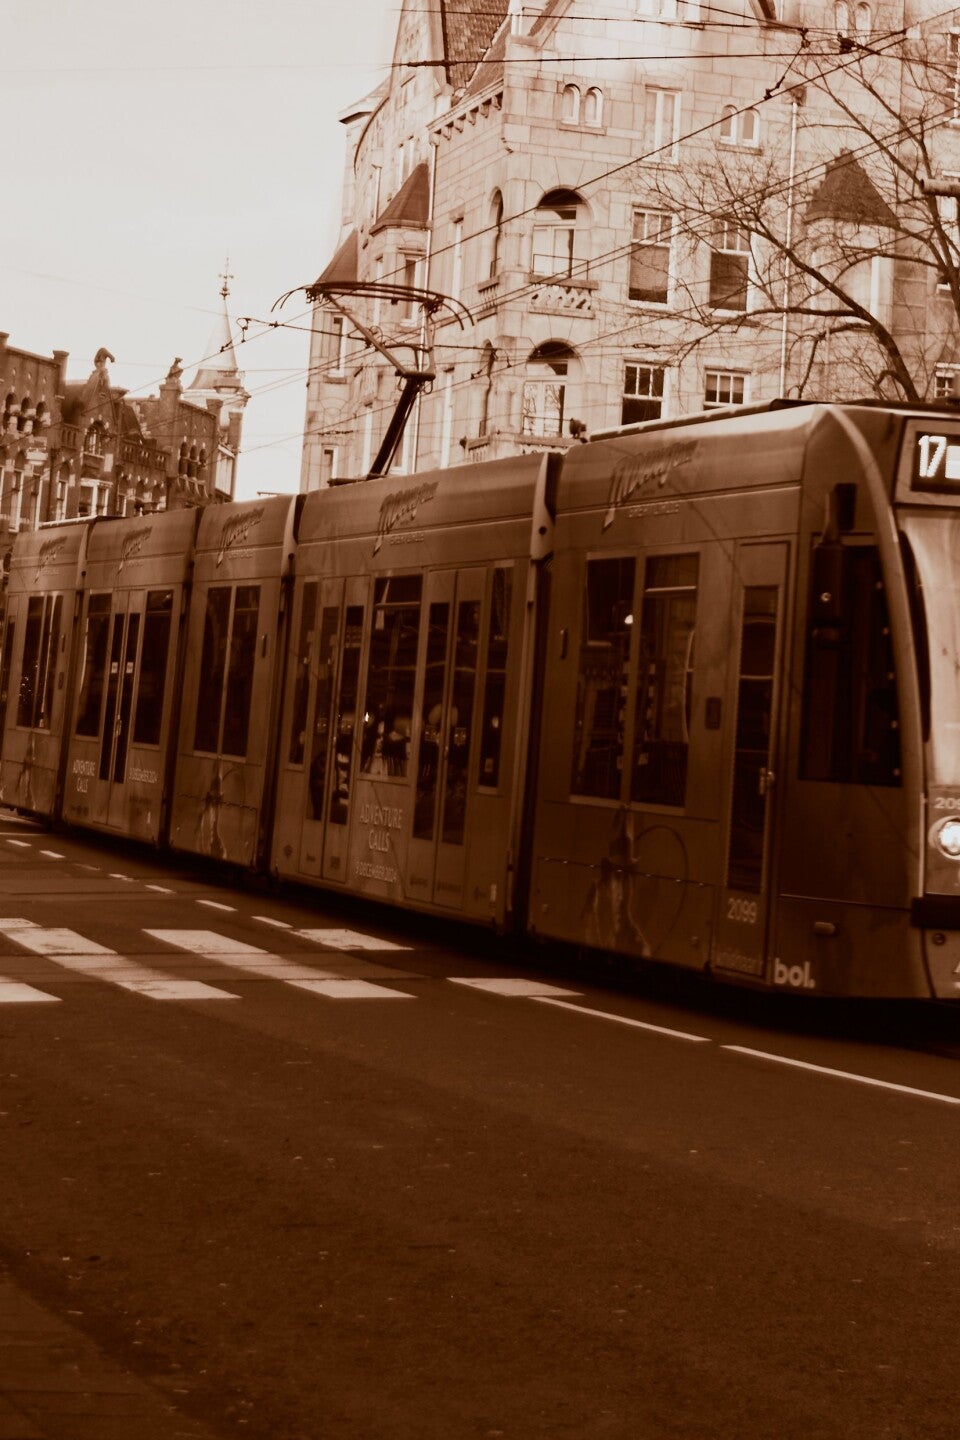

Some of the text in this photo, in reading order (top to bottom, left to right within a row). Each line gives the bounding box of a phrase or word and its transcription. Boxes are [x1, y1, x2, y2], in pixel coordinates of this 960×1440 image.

[918, 433, 947, 478] 17
[359, 804, 403, 830] ADVENTURE
[368, 829, 390, 853] CALLS
[773, 957, 817, 989] bol.
